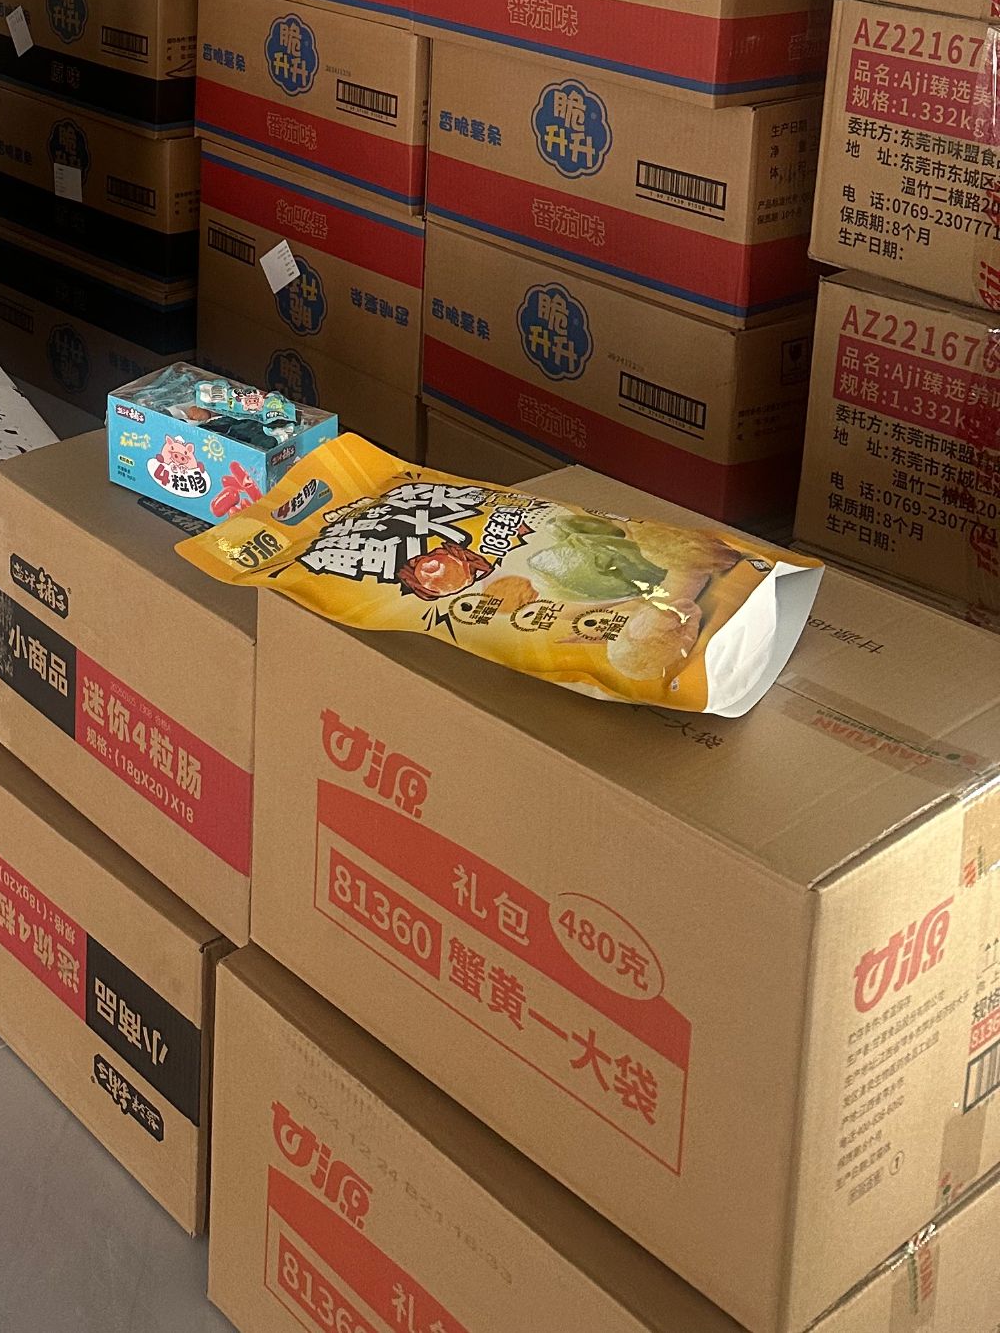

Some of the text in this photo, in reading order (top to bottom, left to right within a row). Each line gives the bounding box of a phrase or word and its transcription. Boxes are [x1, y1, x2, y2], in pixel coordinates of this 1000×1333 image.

[267, 112, 318, 151] 番茄味
[439, 110, 502, 147] 香脆薯条
[531, 198, 606, 247] 番茄味
[838, 228, 903, 261] 生产日期:
[839, 206, 931, 246] 保质期:8个月
[518, 393, 588, 449] 番茄味
[154, 464, 207, 494] 4粒肠
[826, 516, 897, 552] 生产日期:
[827, 492, 925, 542] 保质期:8个月
[13, 561, 68, 614] 盐津铺子
[9, 624, 68, 698] 小商品
[82, 676, 202, 800] 迷你4粒肠
[320, 708, 431, 818] 甘源
[87, 725, 194, 823] 规格:(18gX20)X18
[335, 865, 432, 959] 81360
[559, 908, 651, 991] 480克
[854, 896, 954, 1013] 甘源
[95, 977, 169, 1066] 小商品
[449, 937, 657, 1125] 蟹黄一大袋
[271, 1100, 373, 1230] 甘源
